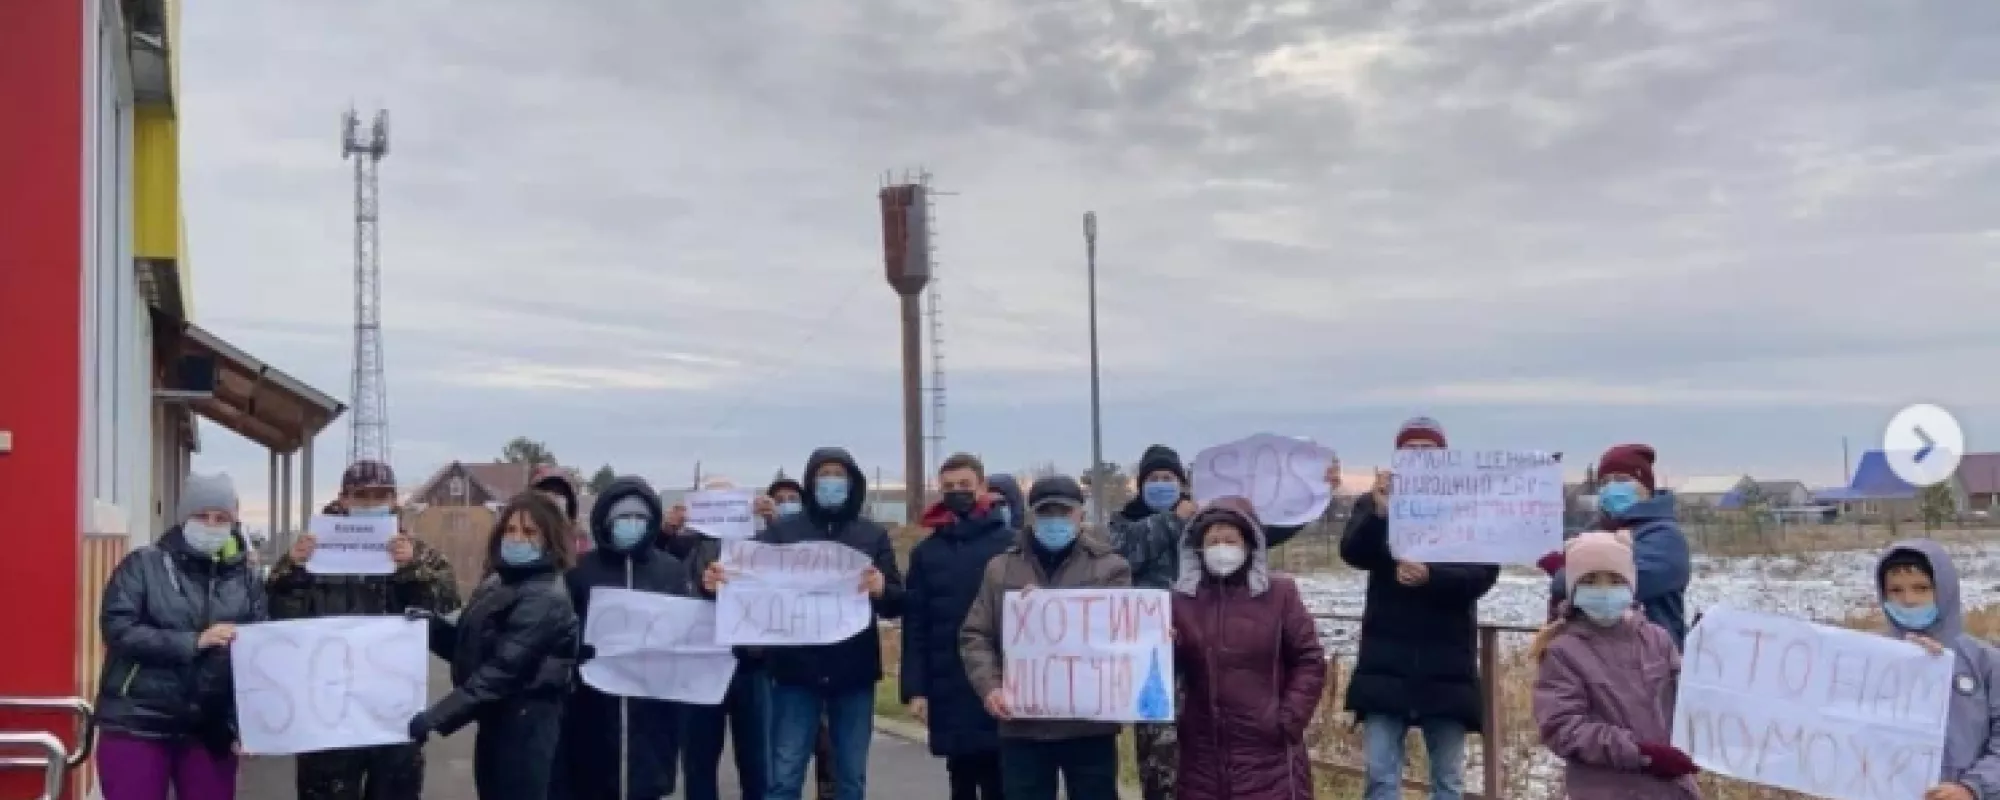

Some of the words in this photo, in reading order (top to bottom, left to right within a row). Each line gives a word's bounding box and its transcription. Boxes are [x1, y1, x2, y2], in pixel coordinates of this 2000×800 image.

[1209, 443, 1318, 516] SOS
[1010, 593, 1169, 646] ХОТИМ
[249, 634, 422, 736] SOS
[1693, 622, 1813, 697] КТО
